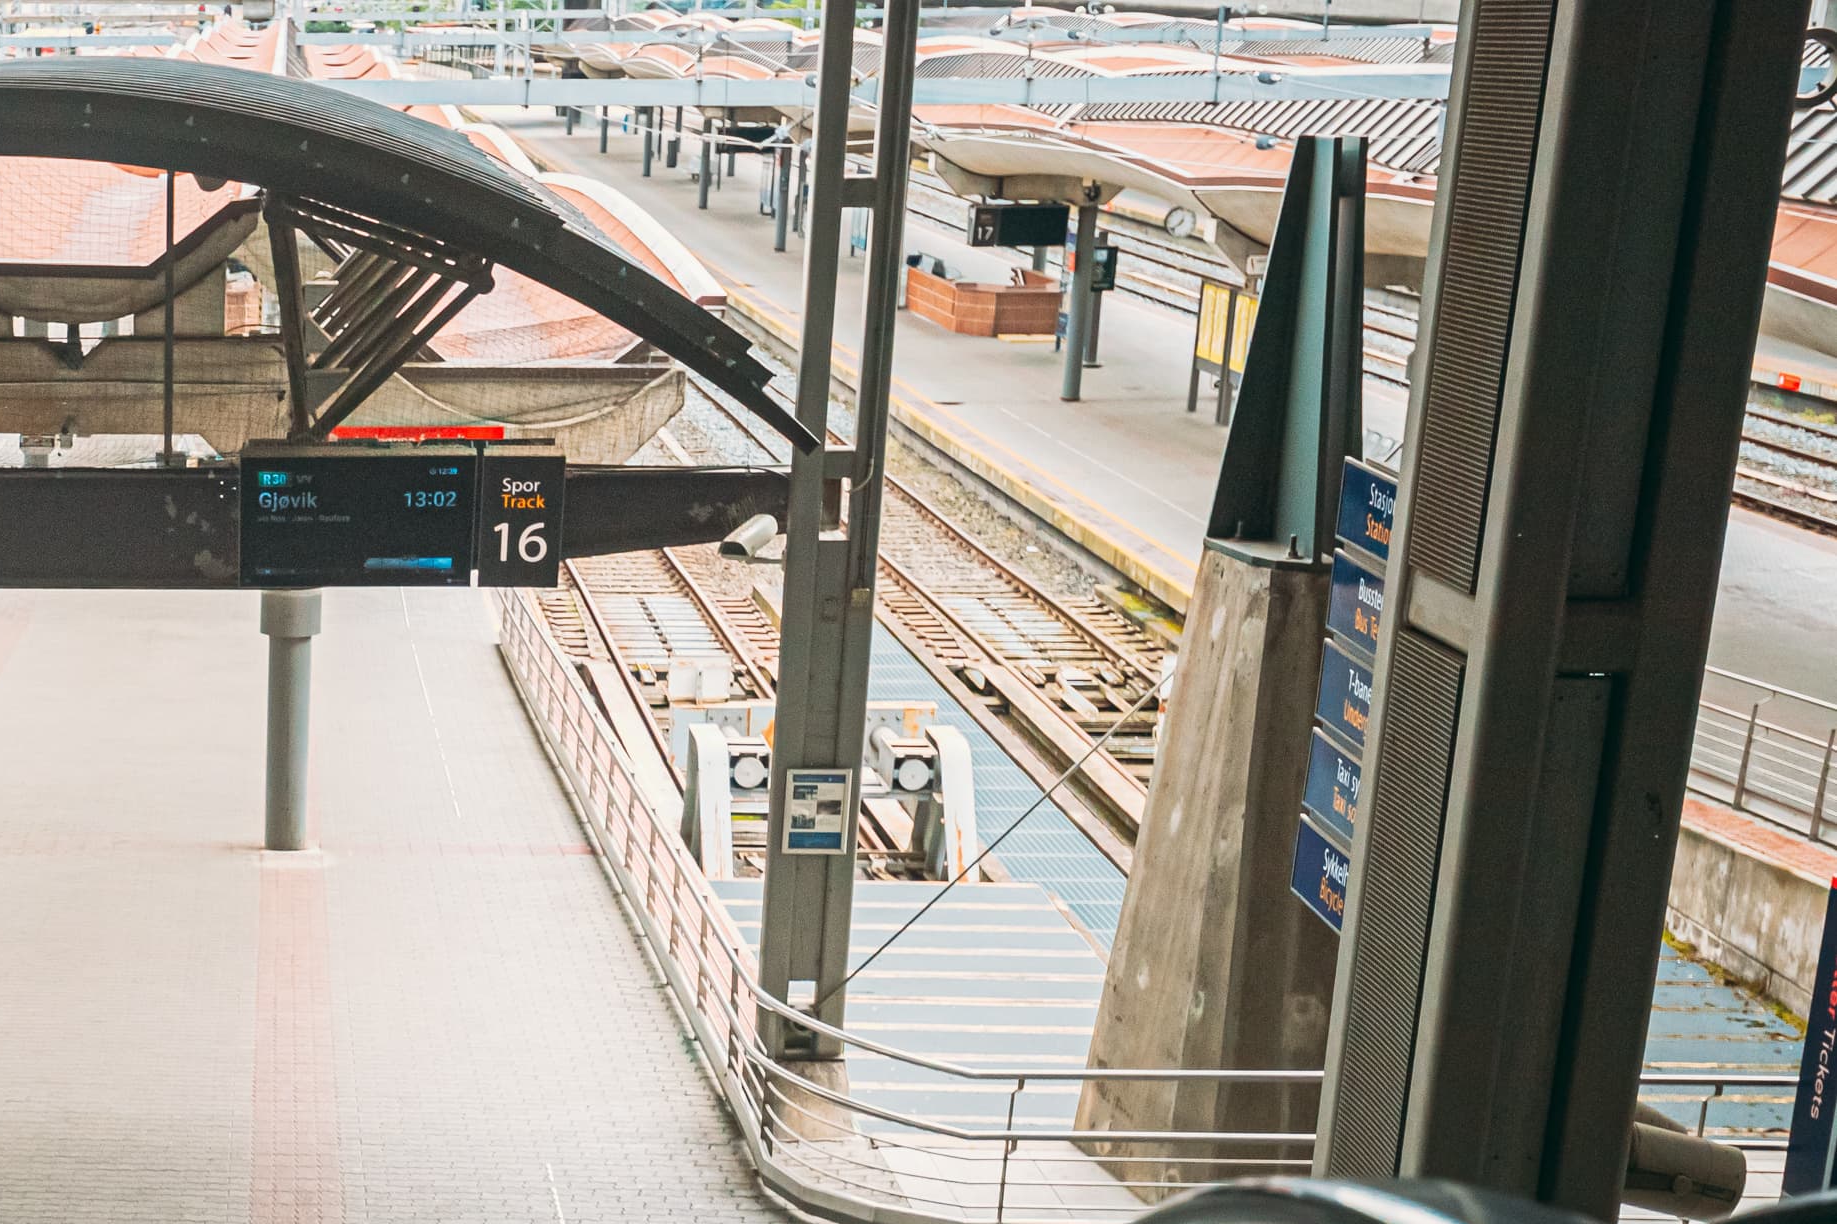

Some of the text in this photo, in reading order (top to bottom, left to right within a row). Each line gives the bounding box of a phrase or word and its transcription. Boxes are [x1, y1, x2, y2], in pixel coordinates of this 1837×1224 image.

[977, 226, 994, 241] 17
[258, 490, 458, 512] Gjøvik 13:02
[501, 494, 546, 510] Track
[502, 478, 541, 494] Spor
[1369, 482, 1396, 518] Stasjo
[493, 522, 548, 563] 16
[1365, 512, 1391, 545] Statio
[1354, 607, 1369, 635] Bus
[1336, 757, 1352, 789] Taxi
[1332, 785, 1347, 817] Taxi
[1319, 876, 1344, 917] Bicycle
[1810, 1026, 1837, 1121] Tickets
